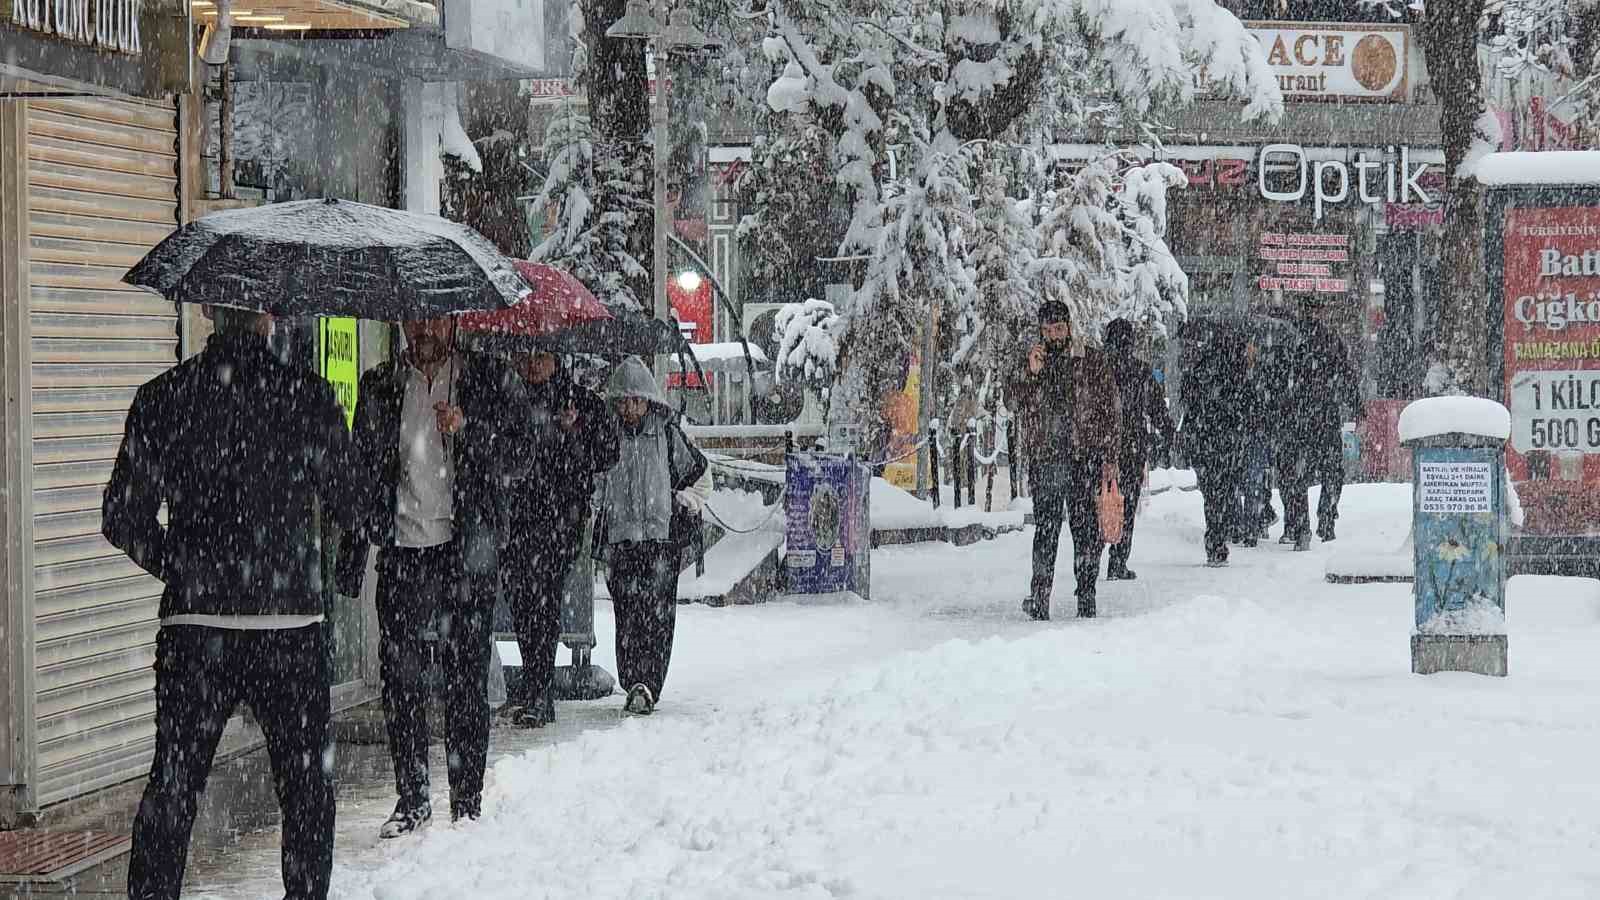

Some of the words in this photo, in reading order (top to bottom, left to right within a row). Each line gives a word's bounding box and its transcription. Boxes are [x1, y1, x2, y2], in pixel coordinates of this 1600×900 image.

[1266, 33, 1345, 66] ACE
[1276, 70, 1327, 91] urant
[1259, 143, 1430, 219] Optik
[1514, 341, 1588, 360] RAMAZANA
[1532, 380, 1541, 410] 1
[1532, 418, 1578, 448] 500
